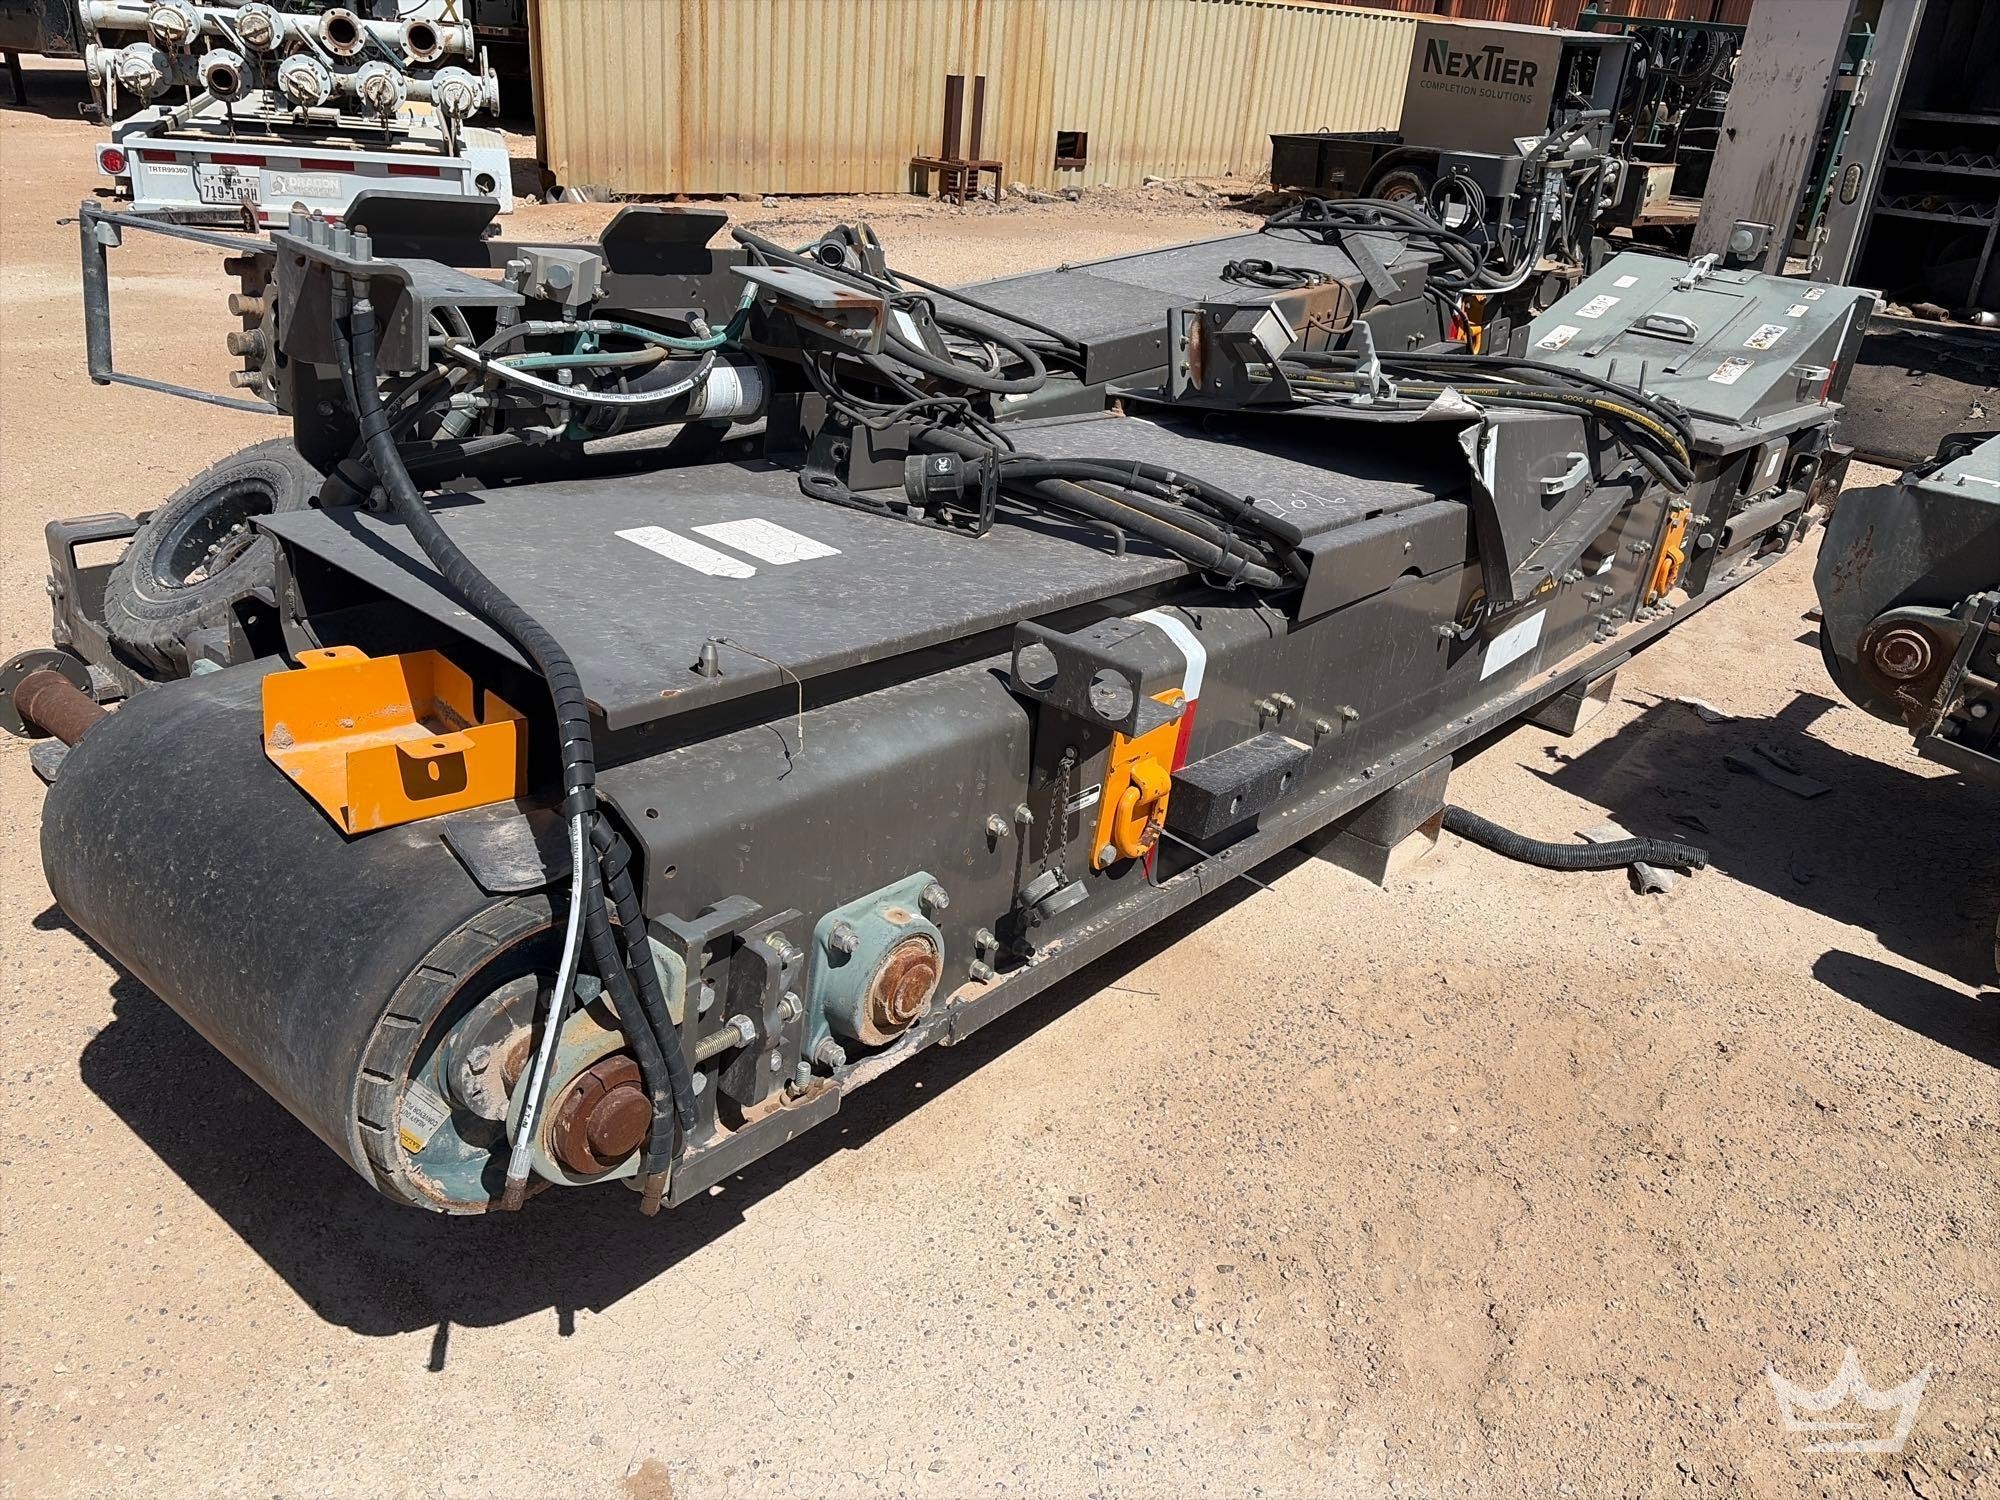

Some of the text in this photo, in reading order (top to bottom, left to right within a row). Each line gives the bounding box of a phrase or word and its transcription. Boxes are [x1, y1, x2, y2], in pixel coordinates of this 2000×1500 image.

[1420, 80, 1533, 104] COMPLETION SOLUTIONS
[412, 1106, 439, 1128] CONVEYOR
